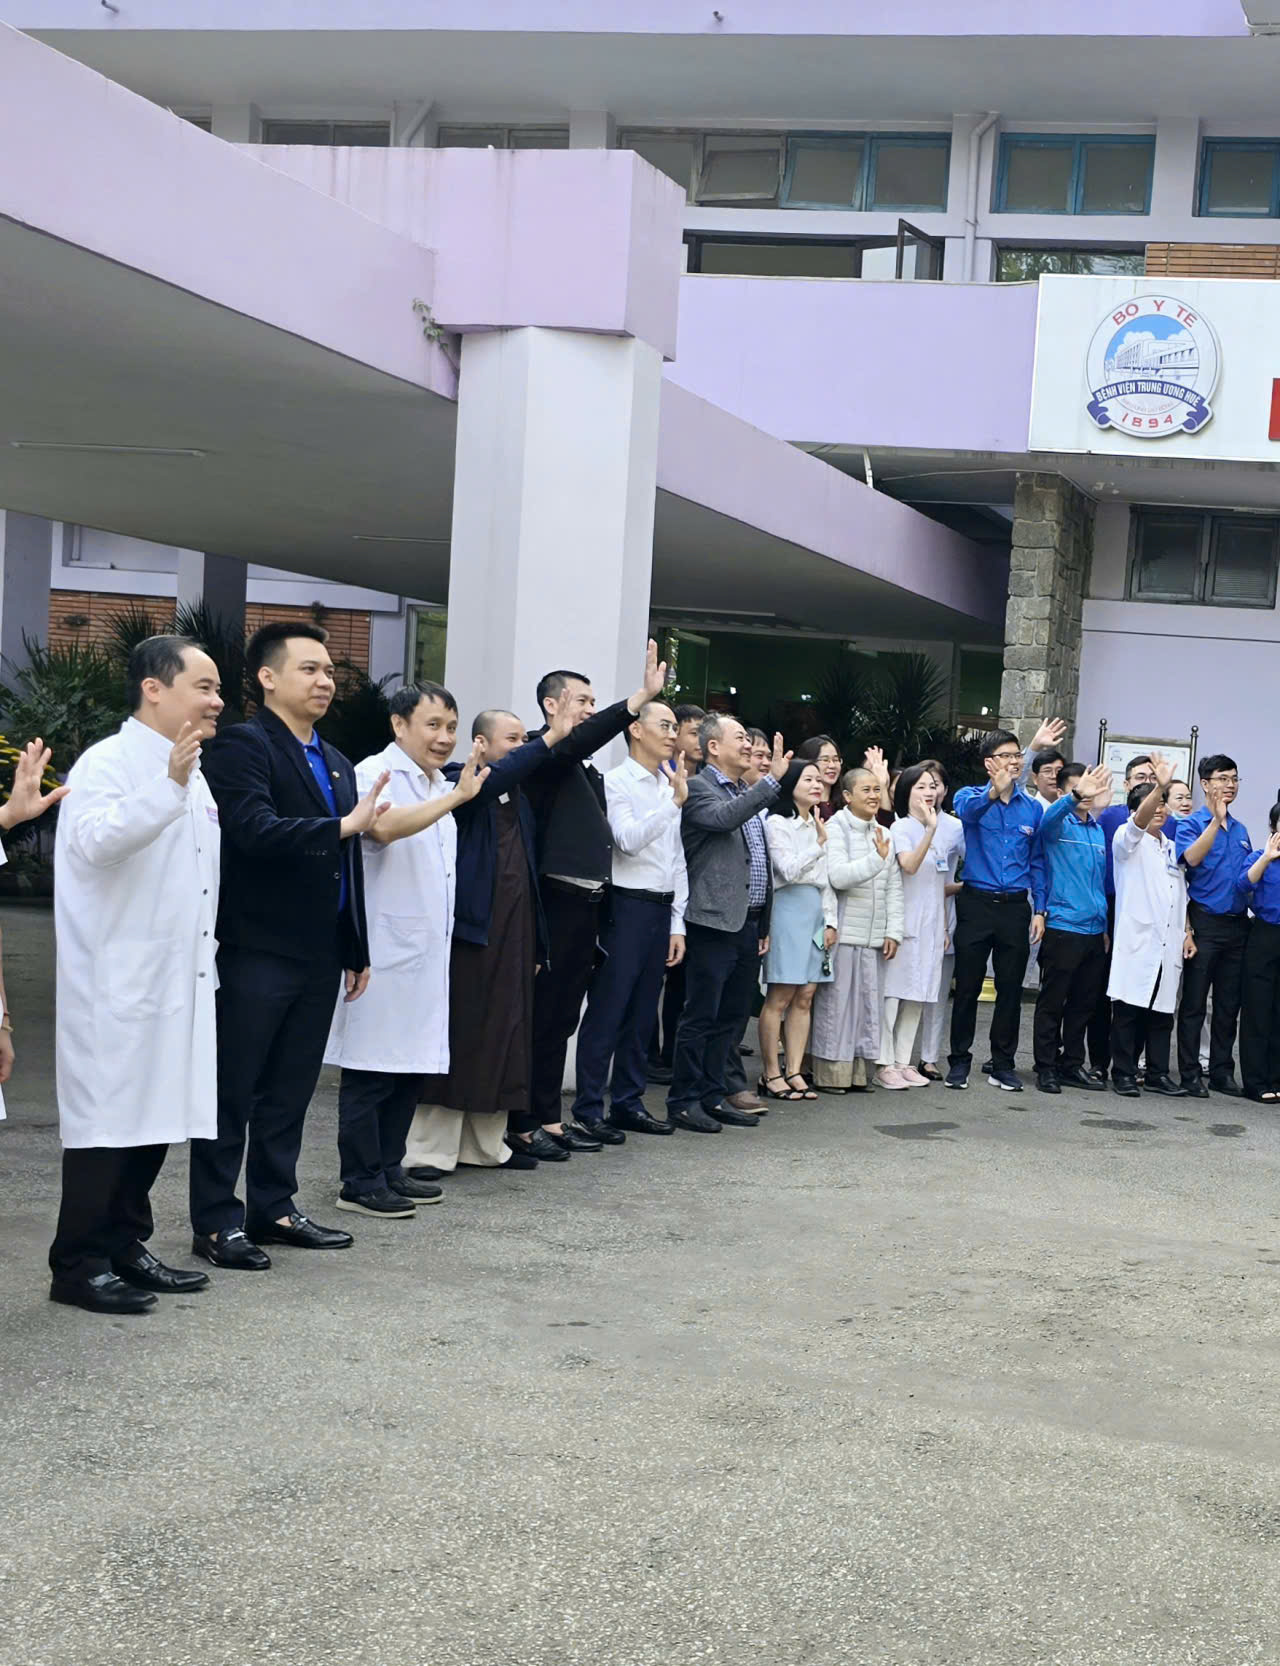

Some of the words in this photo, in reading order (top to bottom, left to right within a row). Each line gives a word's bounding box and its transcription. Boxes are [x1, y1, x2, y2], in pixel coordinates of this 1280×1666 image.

[1153, 299, 1165, 312] Y
[1137, 381, 1162, 393] TRUNG
[1121, 412, 1173, 428] 1894
